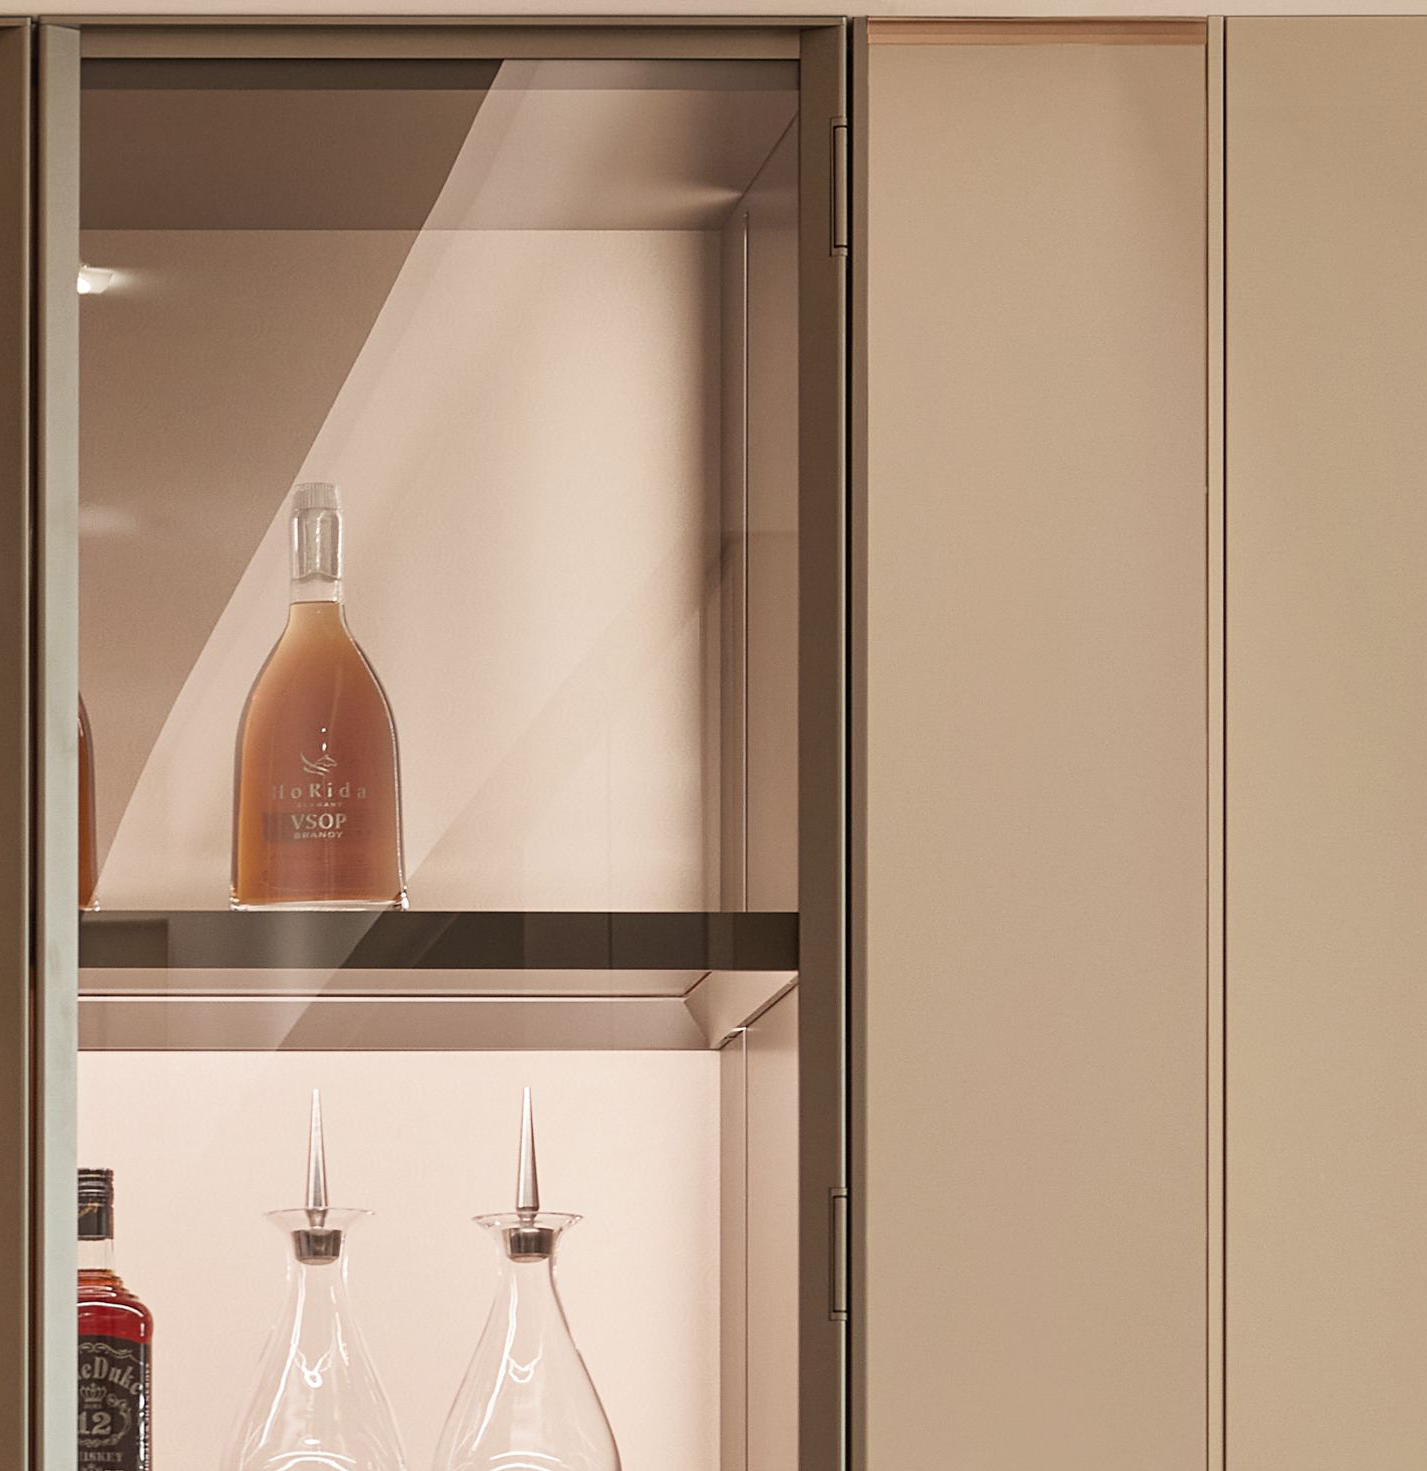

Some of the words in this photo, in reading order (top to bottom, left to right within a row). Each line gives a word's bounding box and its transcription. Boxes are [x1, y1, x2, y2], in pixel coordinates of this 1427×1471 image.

[290, 813, 347, 830] VSOP
[79, 1356, 142, 1396] eDuke
[78, 1410, 112, 1436] 12
[78, 1451, 124, 1463] ISKEY
